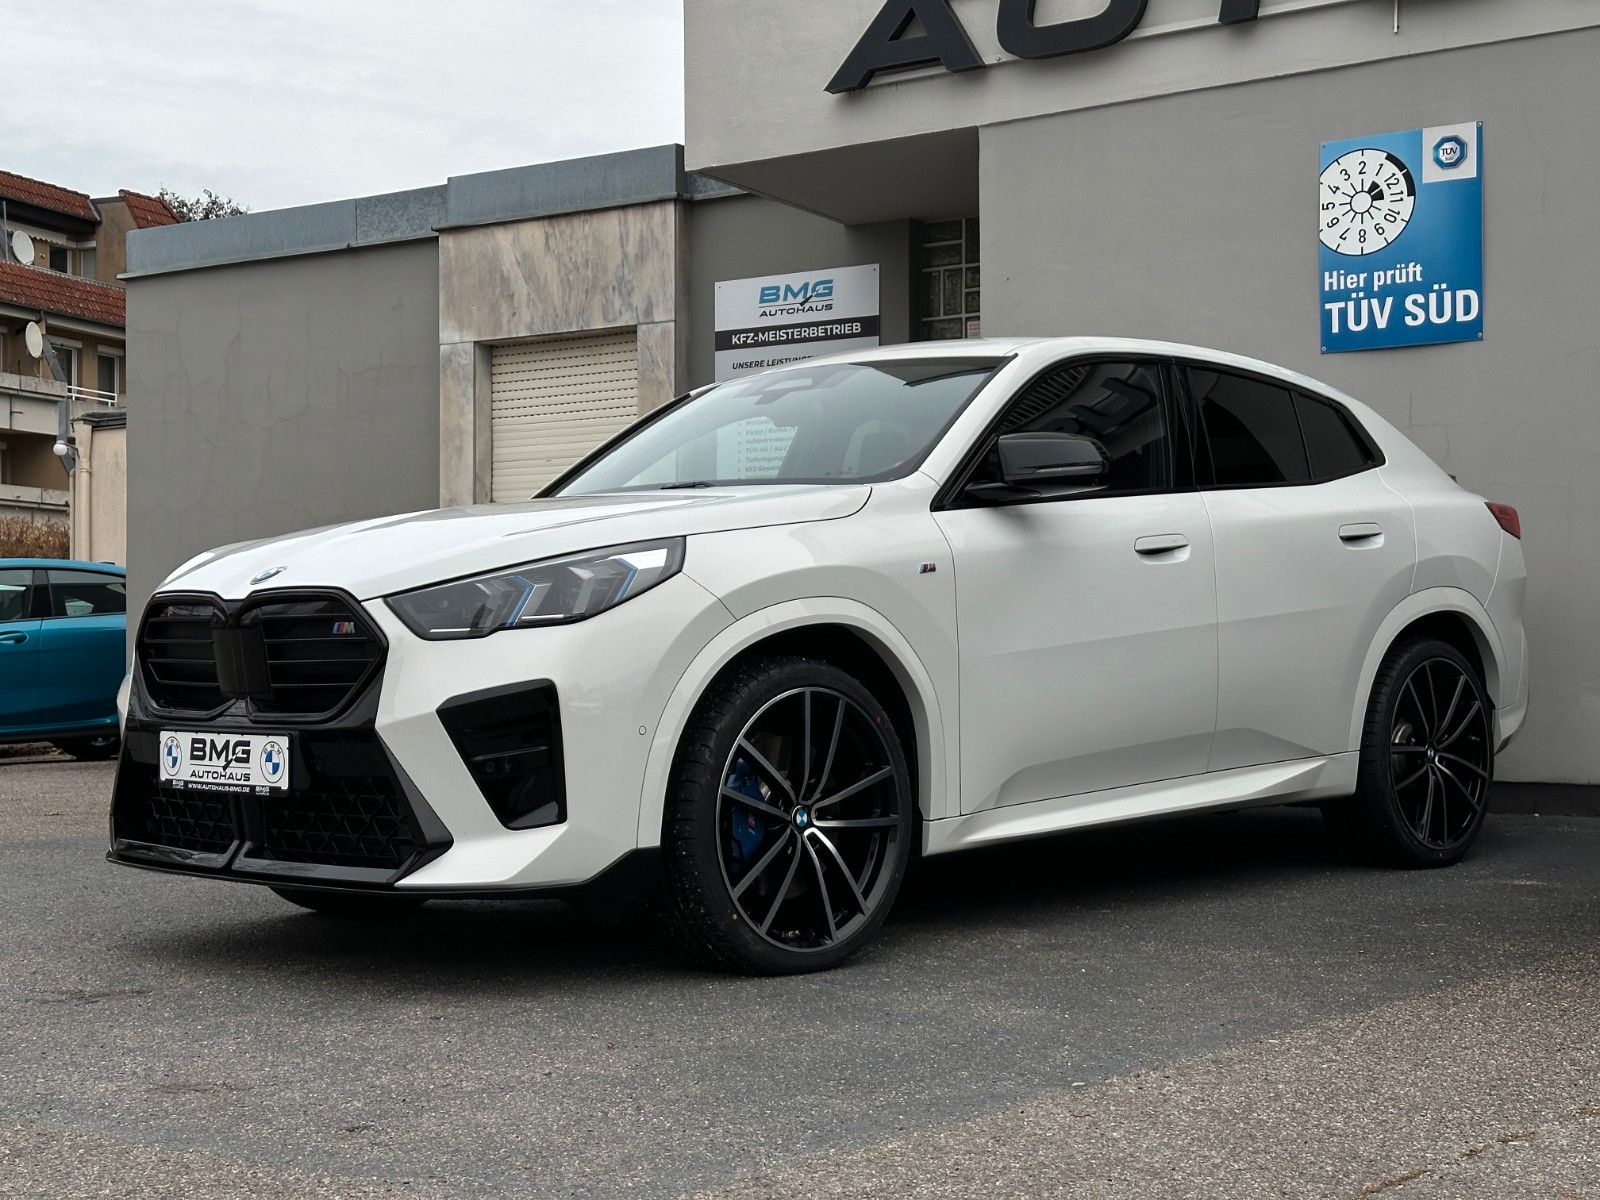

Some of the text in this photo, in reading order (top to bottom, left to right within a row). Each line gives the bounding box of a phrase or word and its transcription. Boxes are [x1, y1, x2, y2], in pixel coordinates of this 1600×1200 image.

[1358, 160, 1366, 175] 2
[1375, 163, 1384, 177] 1
[1339, 168, 1351, 182] 3
[1384, 172, 1400, 190] 12
[1327, 184, 1341, 195] 4
[1389, 190, 1404, 203] 11
[1321, 202, 1336, 211] 5
[1326, 217, 1340, 229] 6
[1383, 208, 1401, 224] 10
[1339, 227, 1351, 241] 7
[1358, 228, 1367, 244] 8
[1374, 222, 1385, 236] 9
[1324, 261, 1423, 291] Hier prüft
[758, 279, 834, 305] BMG
[758, 303, 833, 318] AUTOHAUS
[1324, 282, 1479, 334] TÜV SÜD
[731, 322, 862, 345] KFZ-MEISTERBETRIEB
[732, 359, 765, 370] UNSERE
[189, 738, 252, 764] BMG
[189, 769, 252, 782] AUTOHAUS
[188, 782, 251, 793] WWW.AUTOHAUS-BMG.DE
